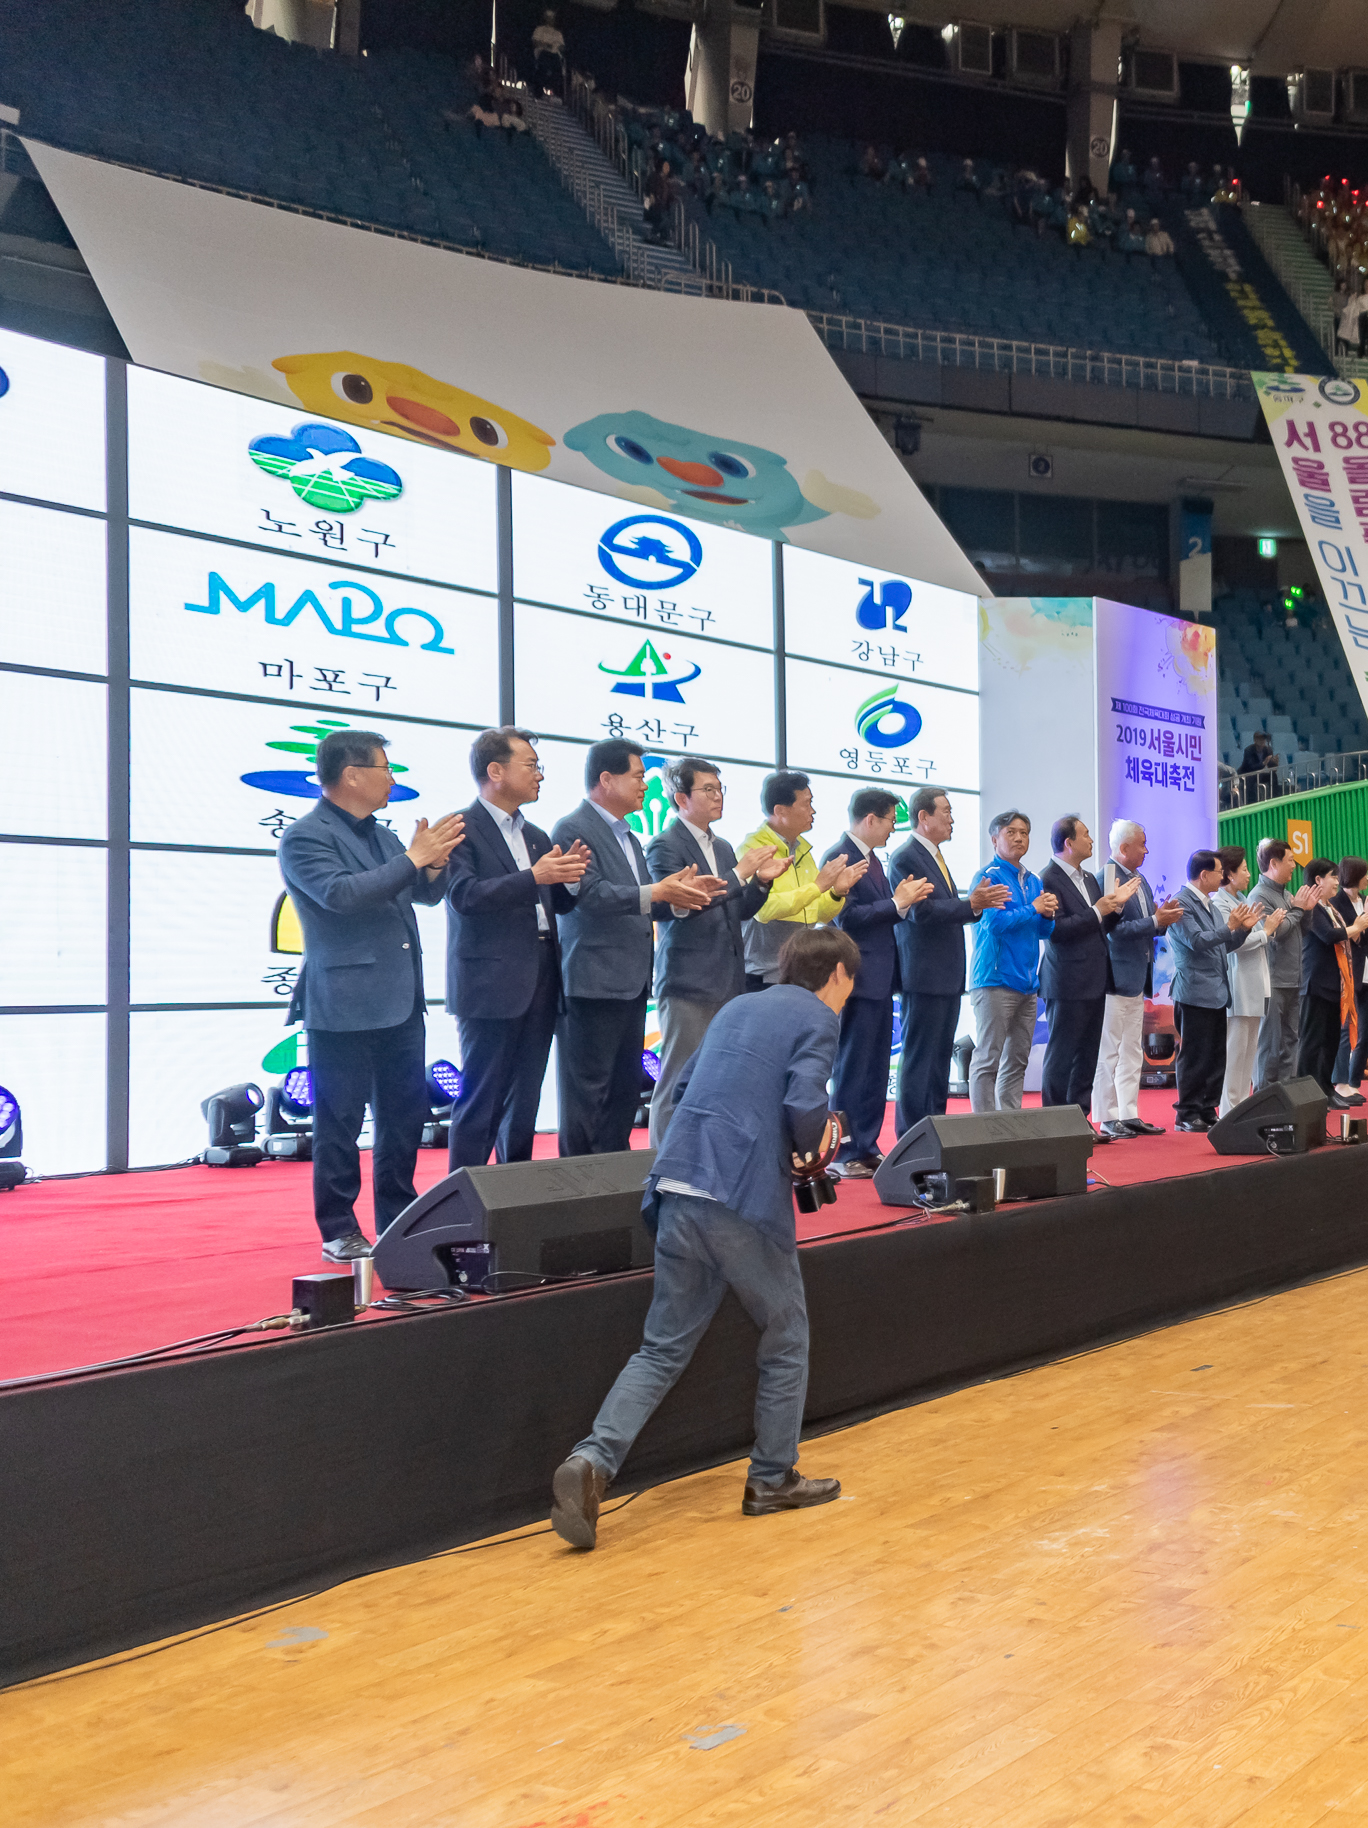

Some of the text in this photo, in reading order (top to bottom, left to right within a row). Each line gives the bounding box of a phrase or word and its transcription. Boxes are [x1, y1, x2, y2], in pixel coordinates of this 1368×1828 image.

[732, 84, 750, 100] 20
[1284, 419, 1343, 531] 서울을
[258, 508, 396, 558] 노원구
[1188, 536, 1202, 558] 2
[184, 570, 455, 654] MAPO
[582, 583, 716, 632] 동대문구
[851, 640, 924, 672] 강남구
[258, 658, 397, 701] 마포구
[601, 712, 699, 747] 용산구
[1116, 724, 1202, 762] 2019 서울시민
[839, 747, 938, 780] 영등포구
[1125, 755, 1195, 792] 체육대축전
[1292, 830, 1308, 855] S1
